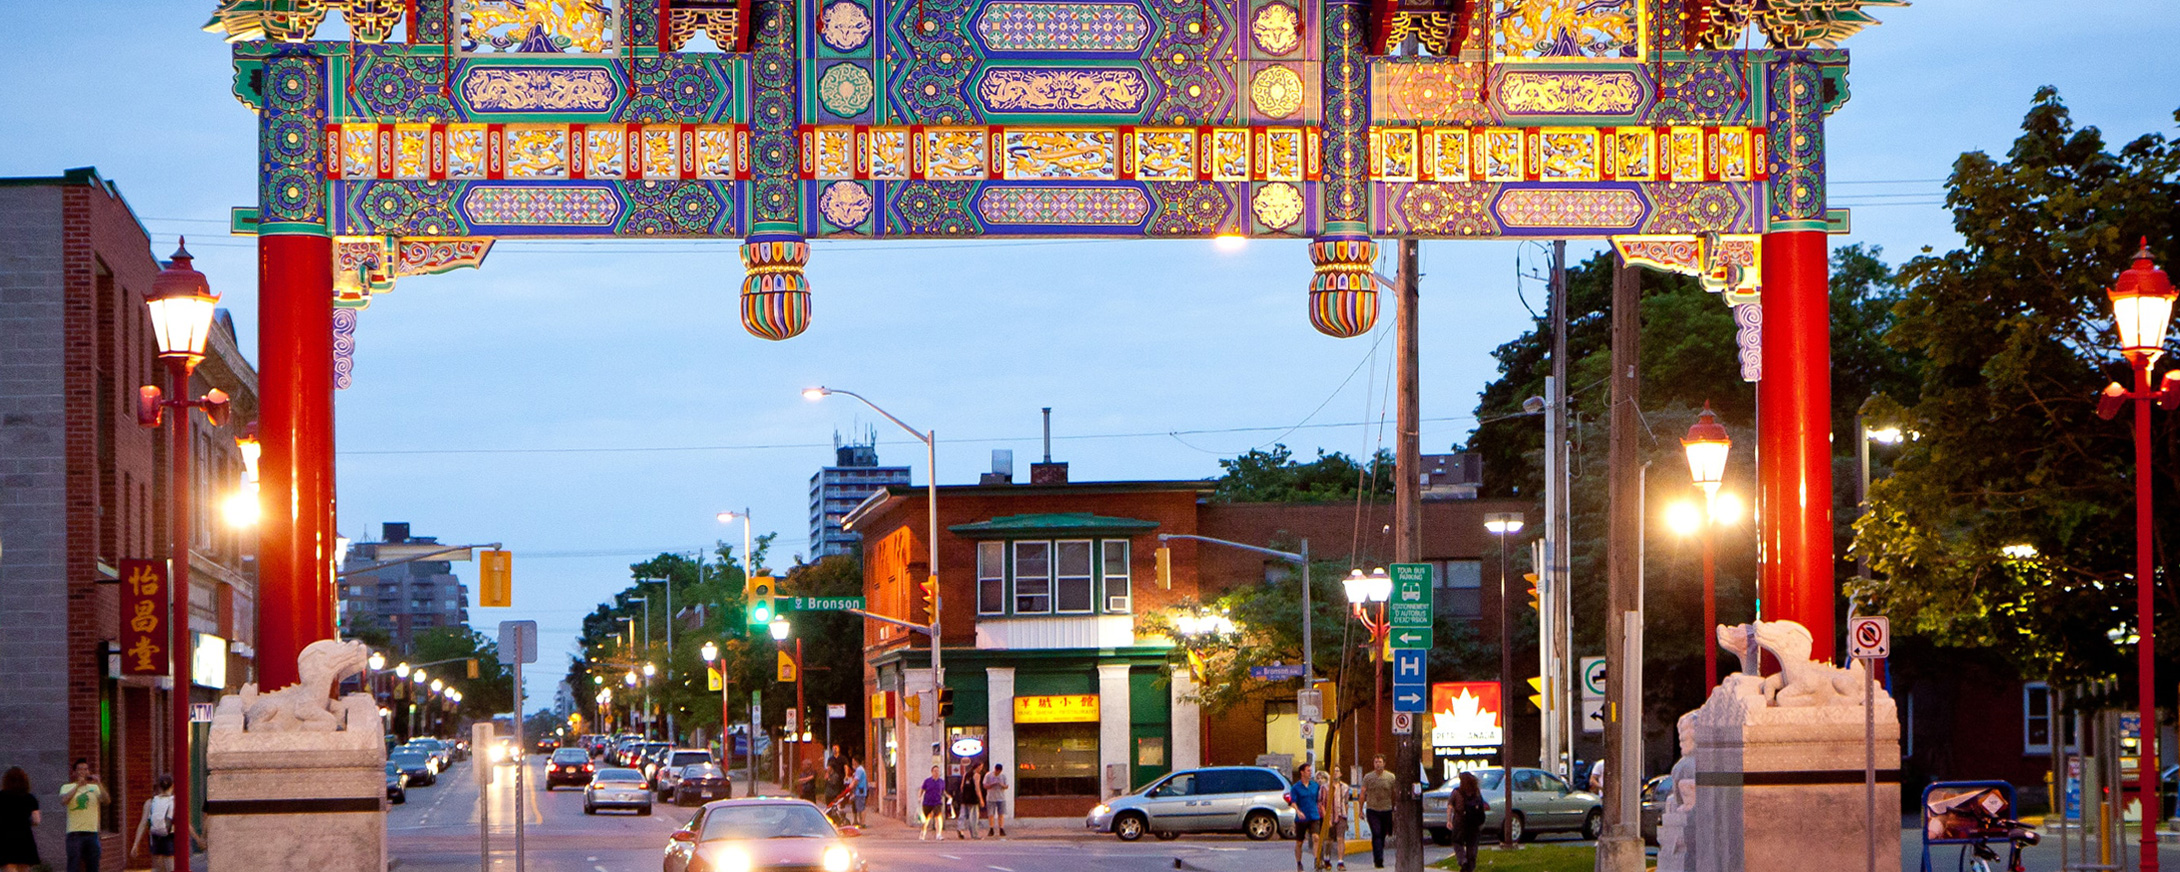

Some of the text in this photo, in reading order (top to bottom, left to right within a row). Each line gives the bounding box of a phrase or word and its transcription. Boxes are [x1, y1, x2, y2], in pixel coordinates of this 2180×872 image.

[808, 597, 859, 609] Bronson
[128, 564, 161, 672] 怡昌堂
[1263, 667, 1288, 675] Bronson
[1401, 656, 1419, 676] H
[189, 704, 212, 720] ATM
